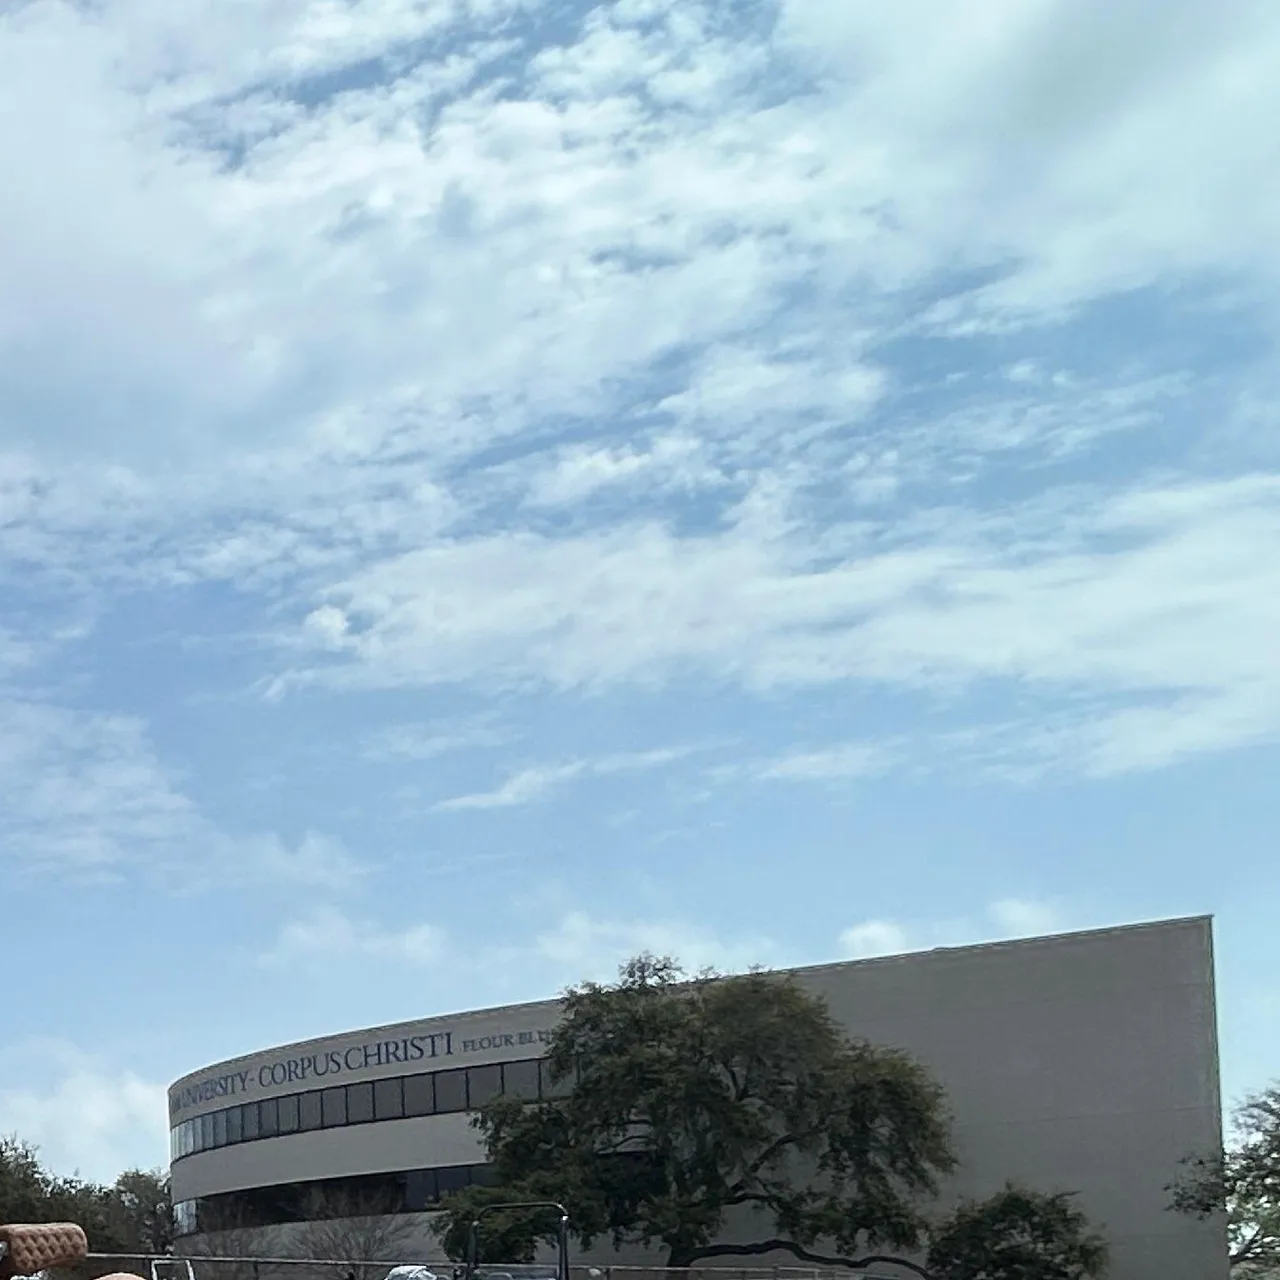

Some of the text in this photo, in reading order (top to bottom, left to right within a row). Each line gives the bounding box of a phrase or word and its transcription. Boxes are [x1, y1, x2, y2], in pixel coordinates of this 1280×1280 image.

[258, 1052, 341, 1089] CORPUS
[344, 1031, 454, 1071] CHRISTI
[462, 1033, 515, 1053] FLOUR
